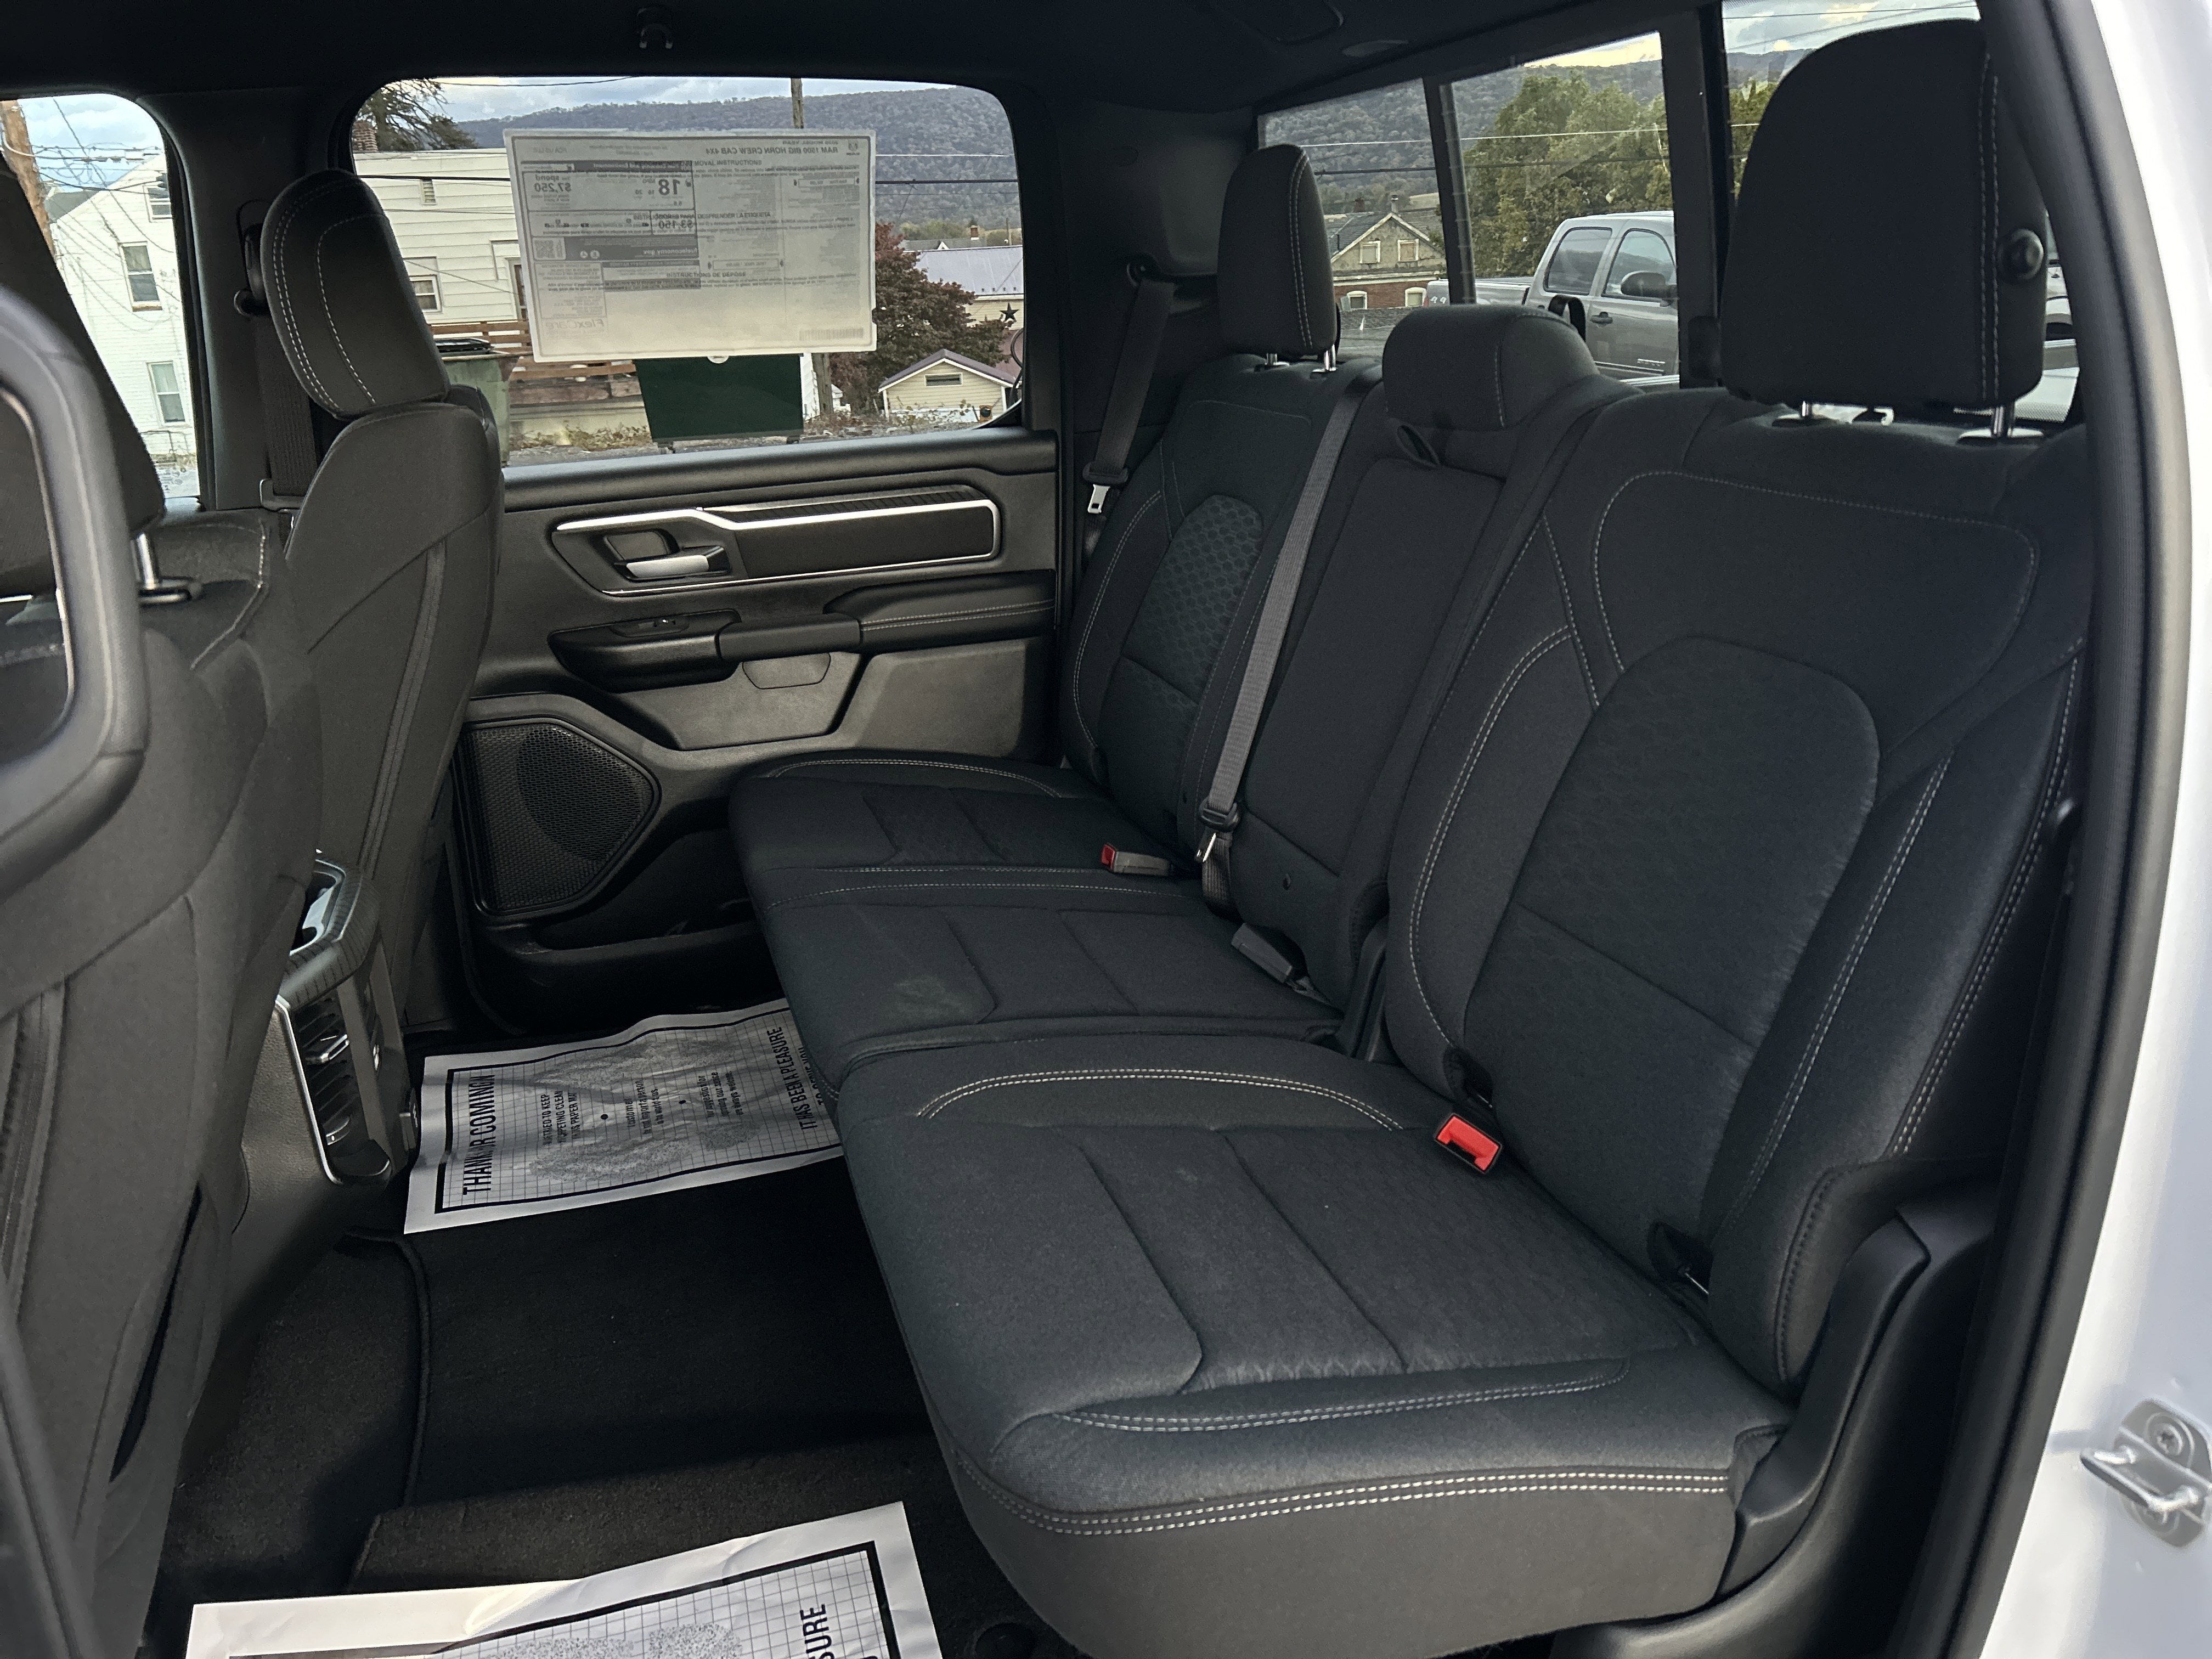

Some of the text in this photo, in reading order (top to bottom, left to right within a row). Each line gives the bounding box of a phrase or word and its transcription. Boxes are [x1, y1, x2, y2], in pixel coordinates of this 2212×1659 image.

[766, 1026, 797, 1075] PLEASURE
[783, 1073, 798, 1081] A
[785, 1079, 808, 1104] BEEN
[541, 1094, 550, 1110] KEEP
[542, 1110, 551, 1119] TO
[569, 1103, 579, 1124] PAPER
[793, 1103, 815, 1120] HAS
[799, 1121, 818, 1130] IT
